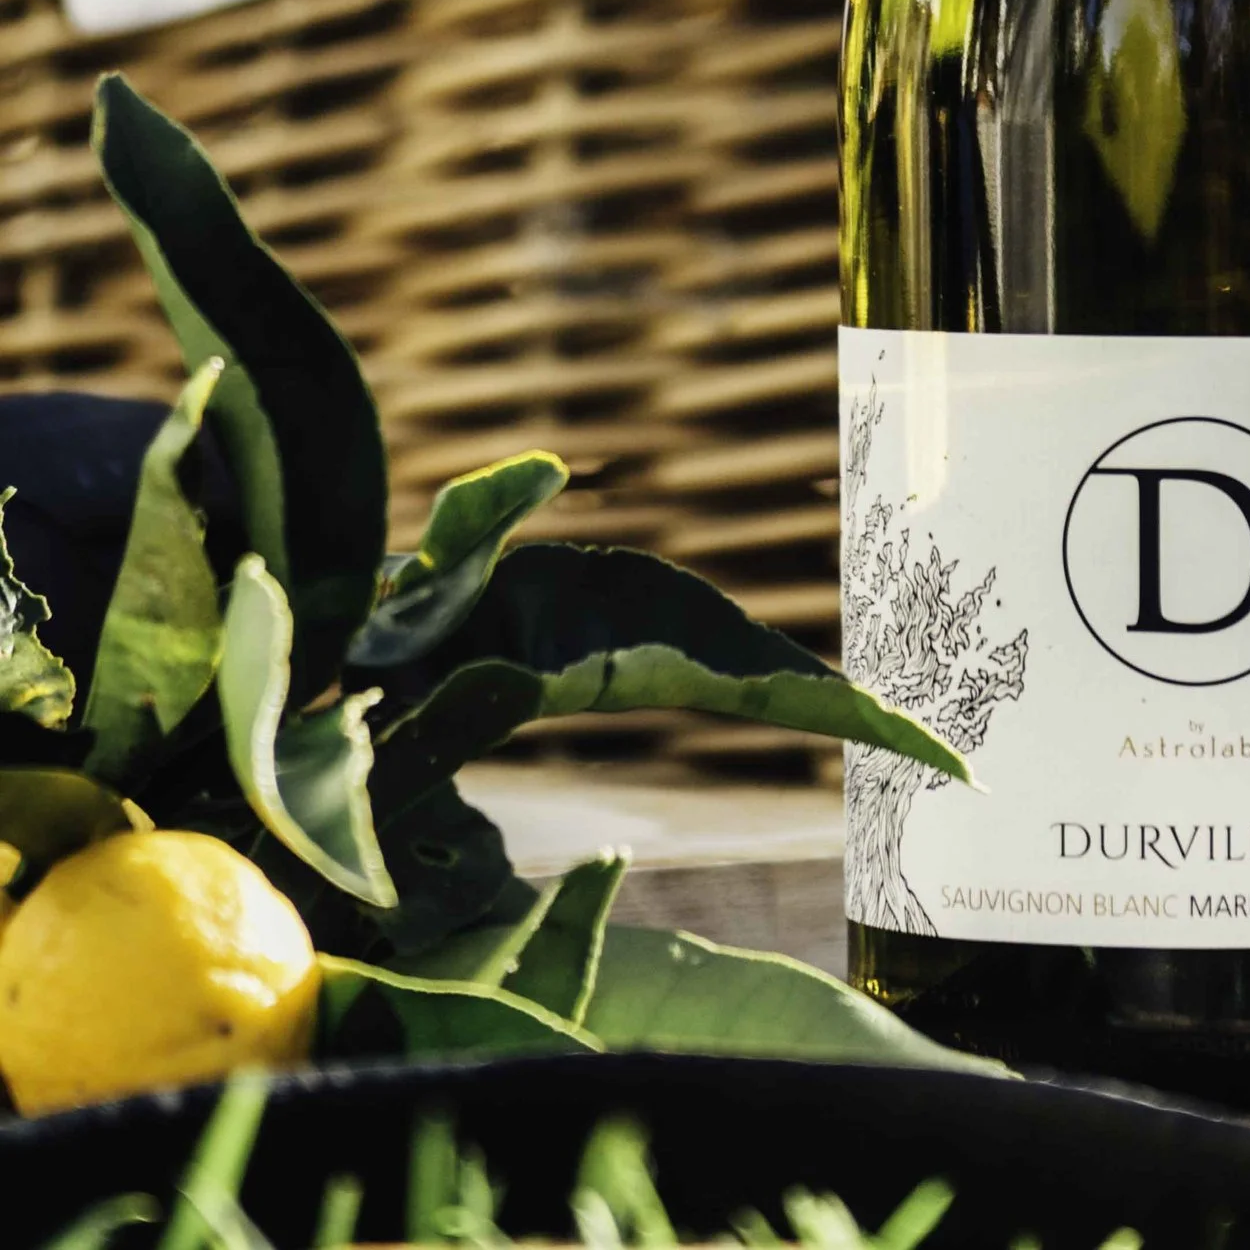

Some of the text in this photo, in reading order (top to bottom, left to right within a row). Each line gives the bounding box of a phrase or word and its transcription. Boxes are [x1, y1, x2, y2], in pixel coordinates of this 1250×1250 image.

[1188, 719, 1205, 735] by
[941, 885, 1083, 915] SAUVIGNON
[1093, 892, 1178, 918] BLANC
